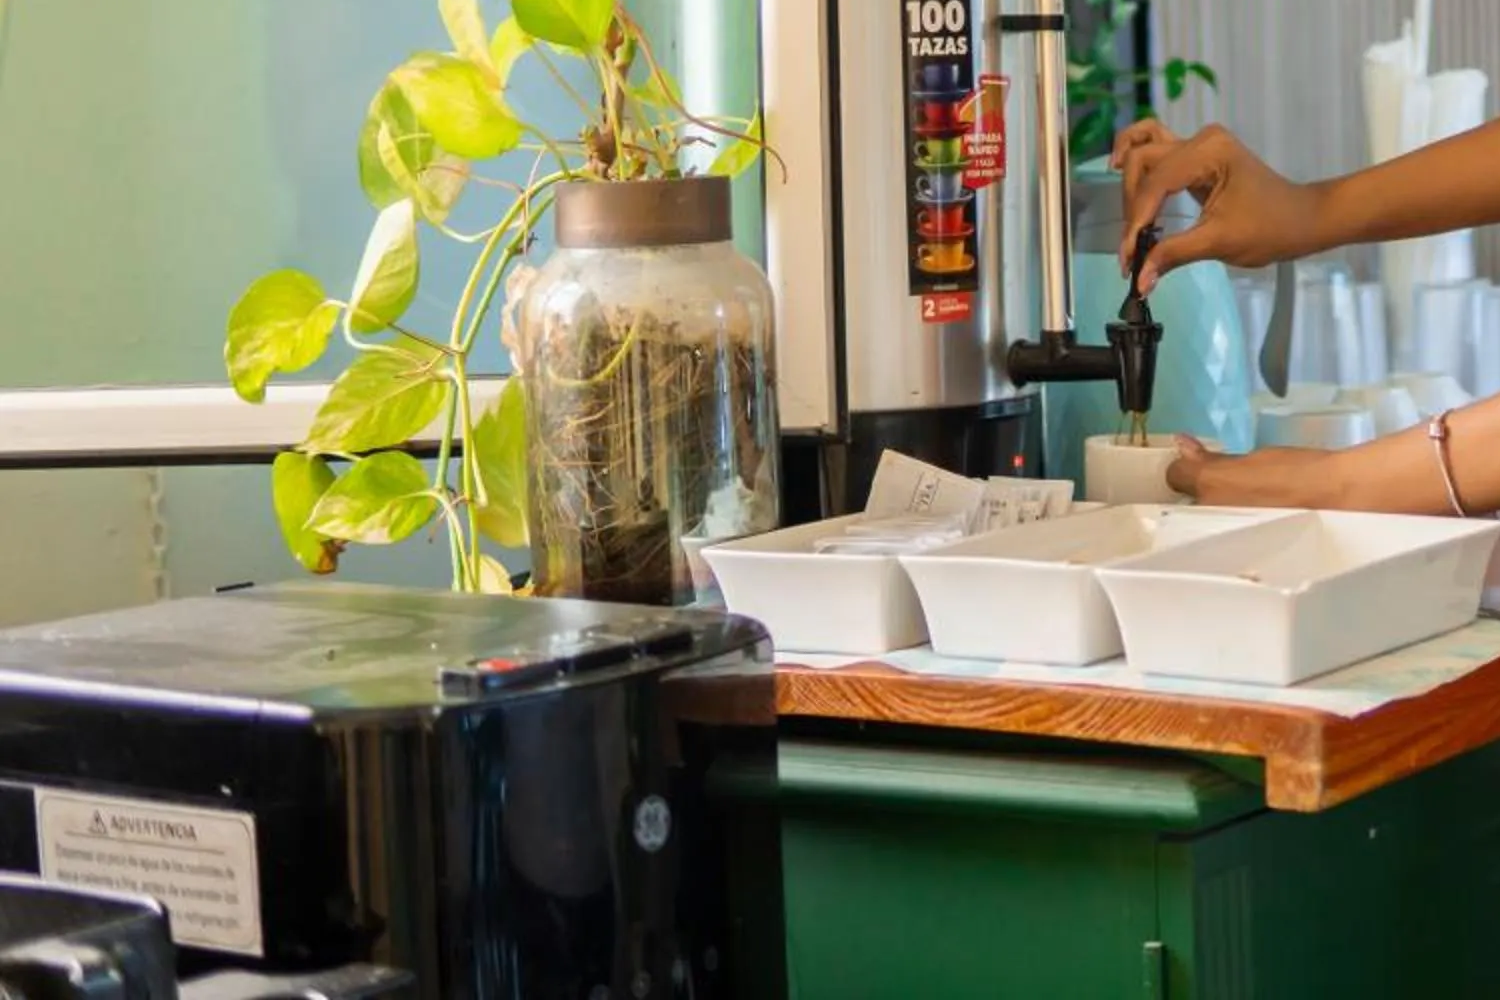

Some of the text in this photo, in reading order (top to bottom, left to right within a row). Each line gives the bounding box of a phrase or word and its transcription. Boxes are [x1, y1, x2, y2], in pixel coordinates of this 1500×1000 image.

[906, 0, 965, 33] 100
[908, 36, 968, 56] TAZAS
[923, 299, 936, 318] 2
[110, 816, 197, 841] ADVERTENCIA
